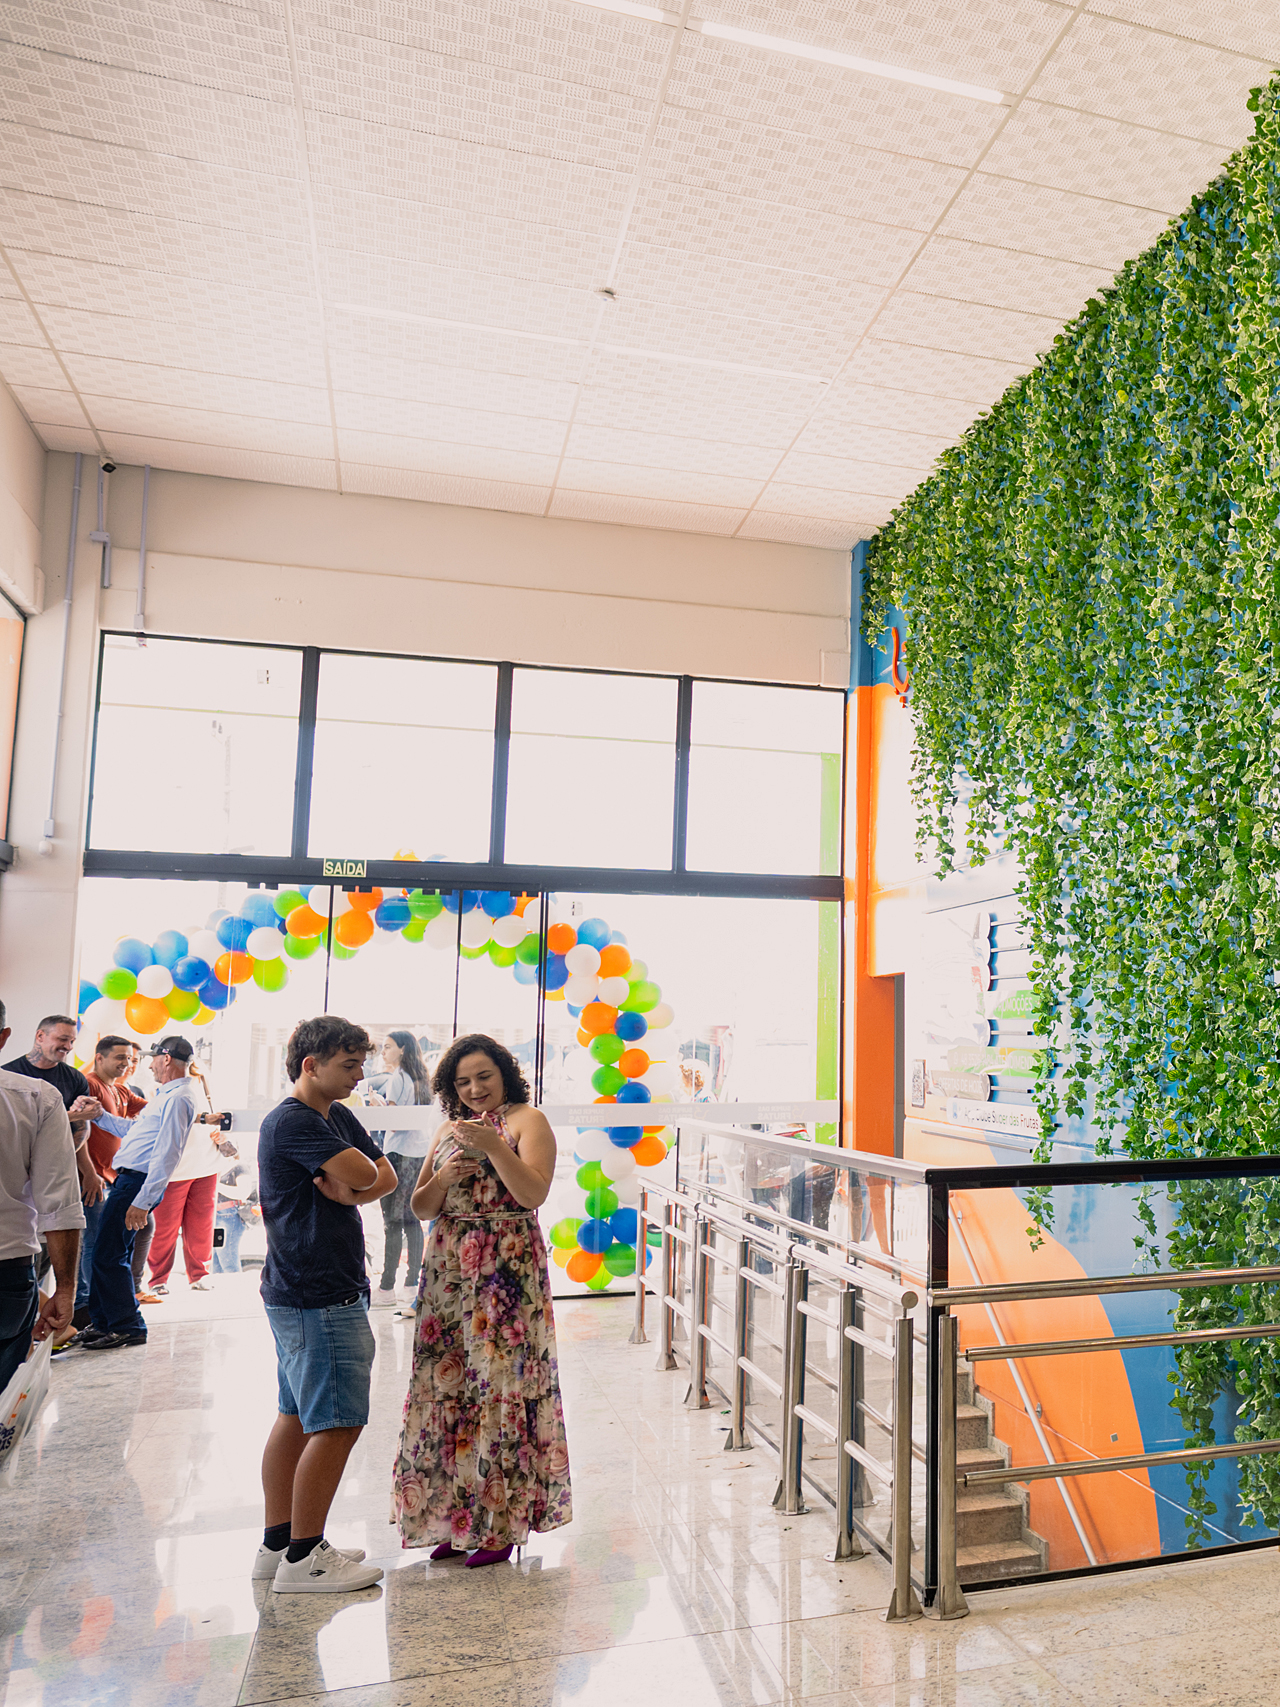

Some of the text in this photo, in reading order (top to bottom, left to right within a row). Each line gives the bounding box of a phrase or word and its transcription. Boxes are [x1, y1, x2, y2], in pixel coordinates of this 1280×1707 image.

[325, 859, 364, 875] SAÍDA
[938, 1077, 960, 1091] OFERTAS
[960, 1079, 968, 1092] DE
[1020, 1113, 1039, 1130] Frutas
